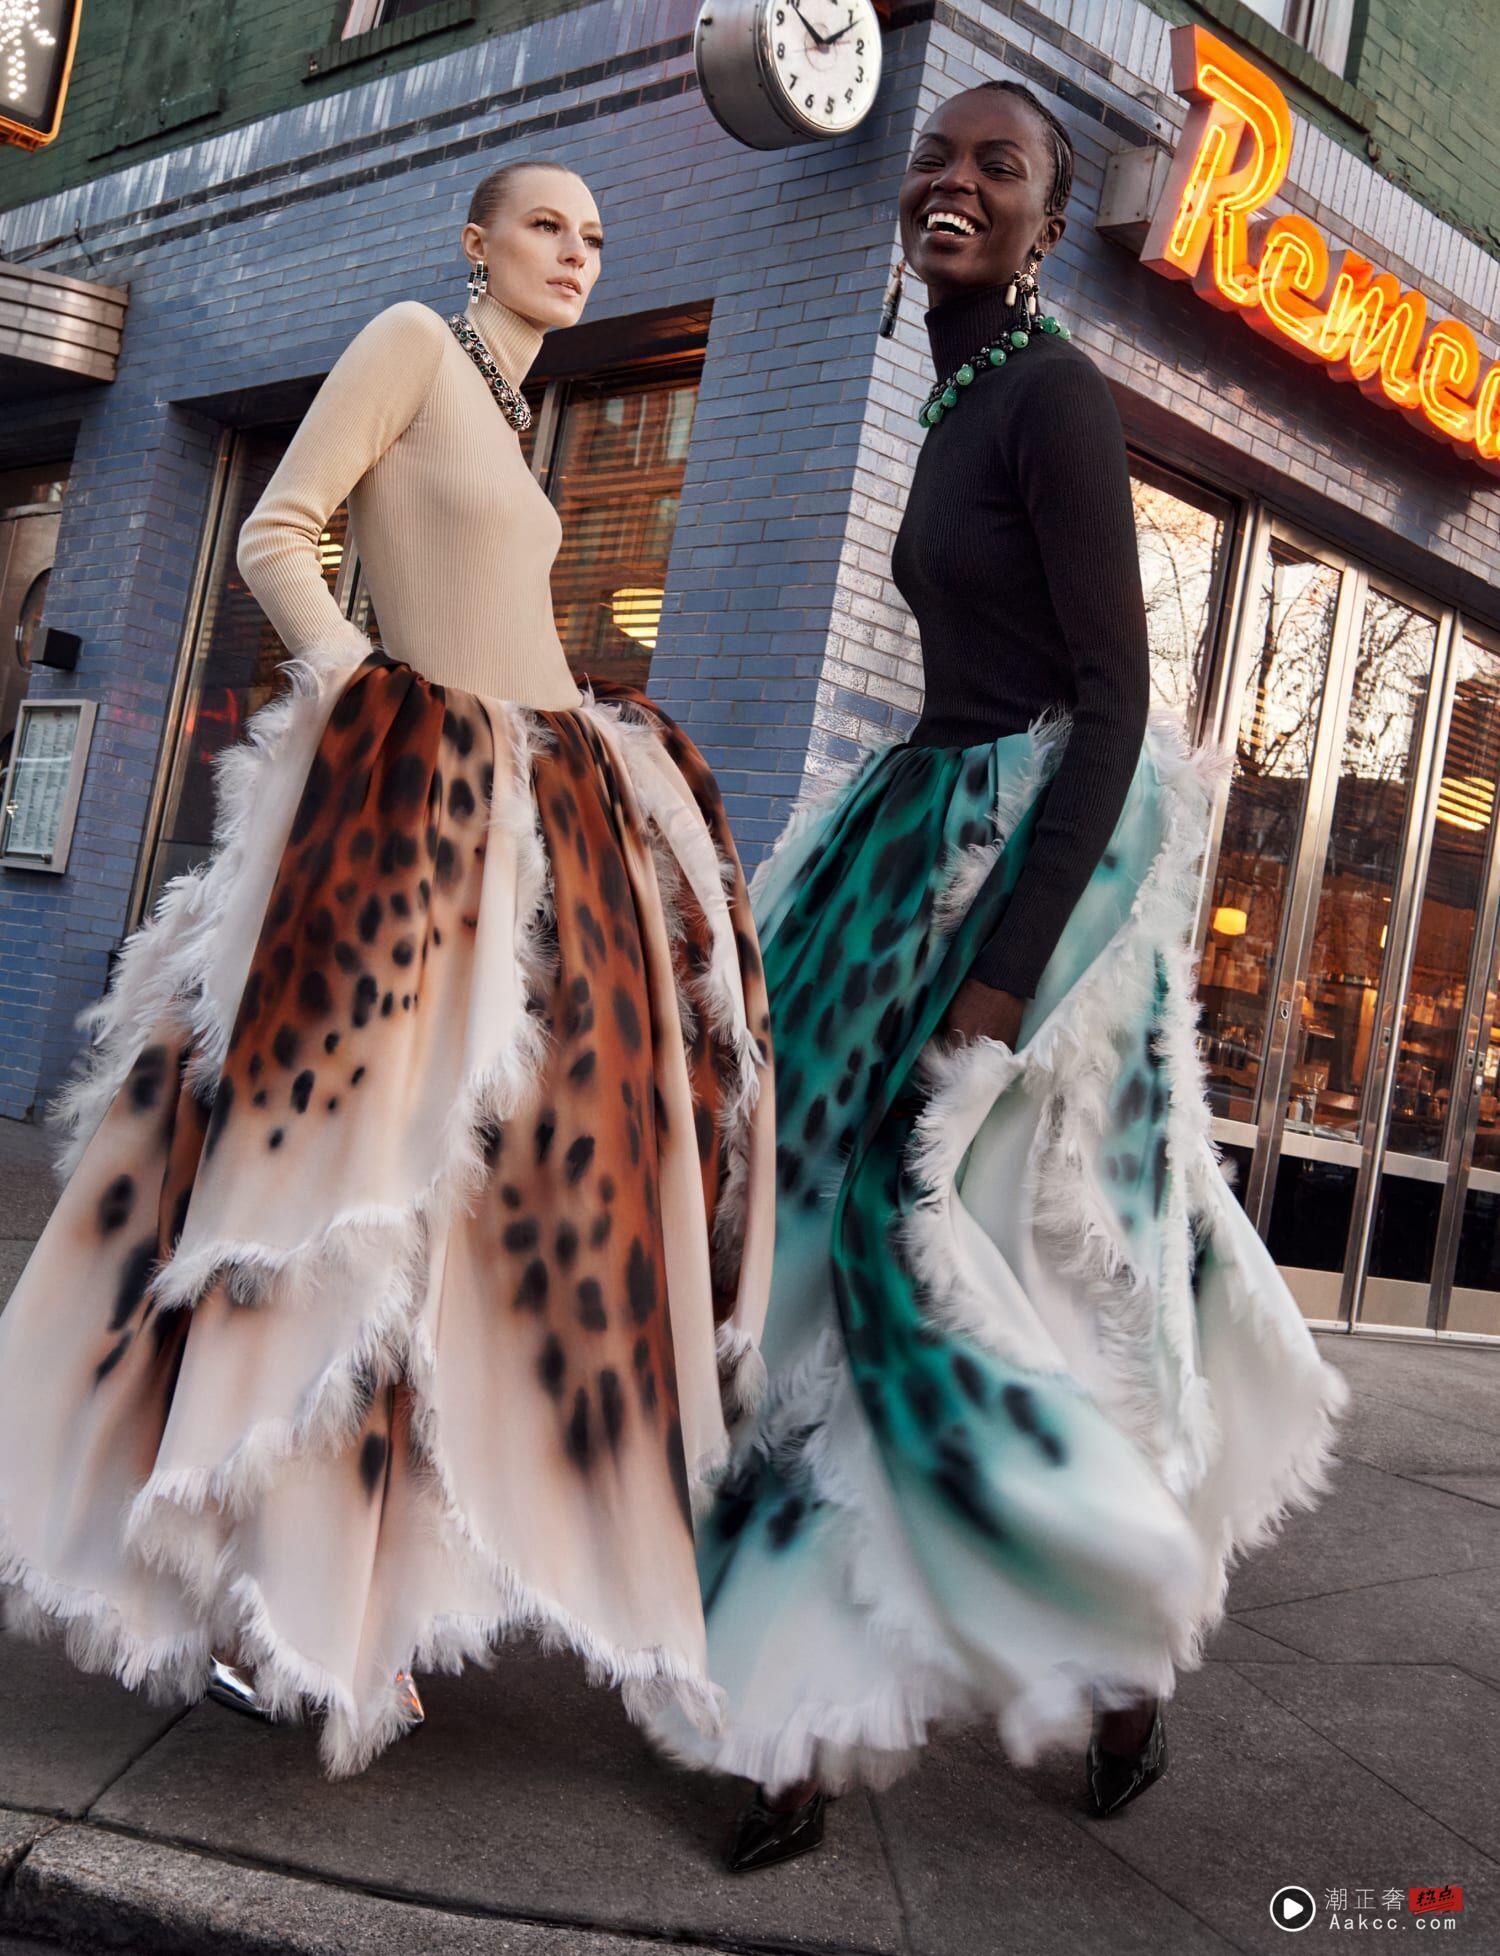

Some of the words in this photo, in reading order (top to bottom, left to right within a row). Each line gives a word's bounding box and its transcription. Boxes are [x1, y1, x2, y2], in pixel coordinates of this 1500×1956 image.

[776, 10, 784, 26] 9
[777, 42, 785, 59] 8
[856, 38, 864, 56] 2
[789, 73, 798, 91] 7
[855, 65, 864, 83] 3
[805, 94, 814, 109] 6
[844, 88, 853, 104] 4
[825, 96, 835, 114] 5
